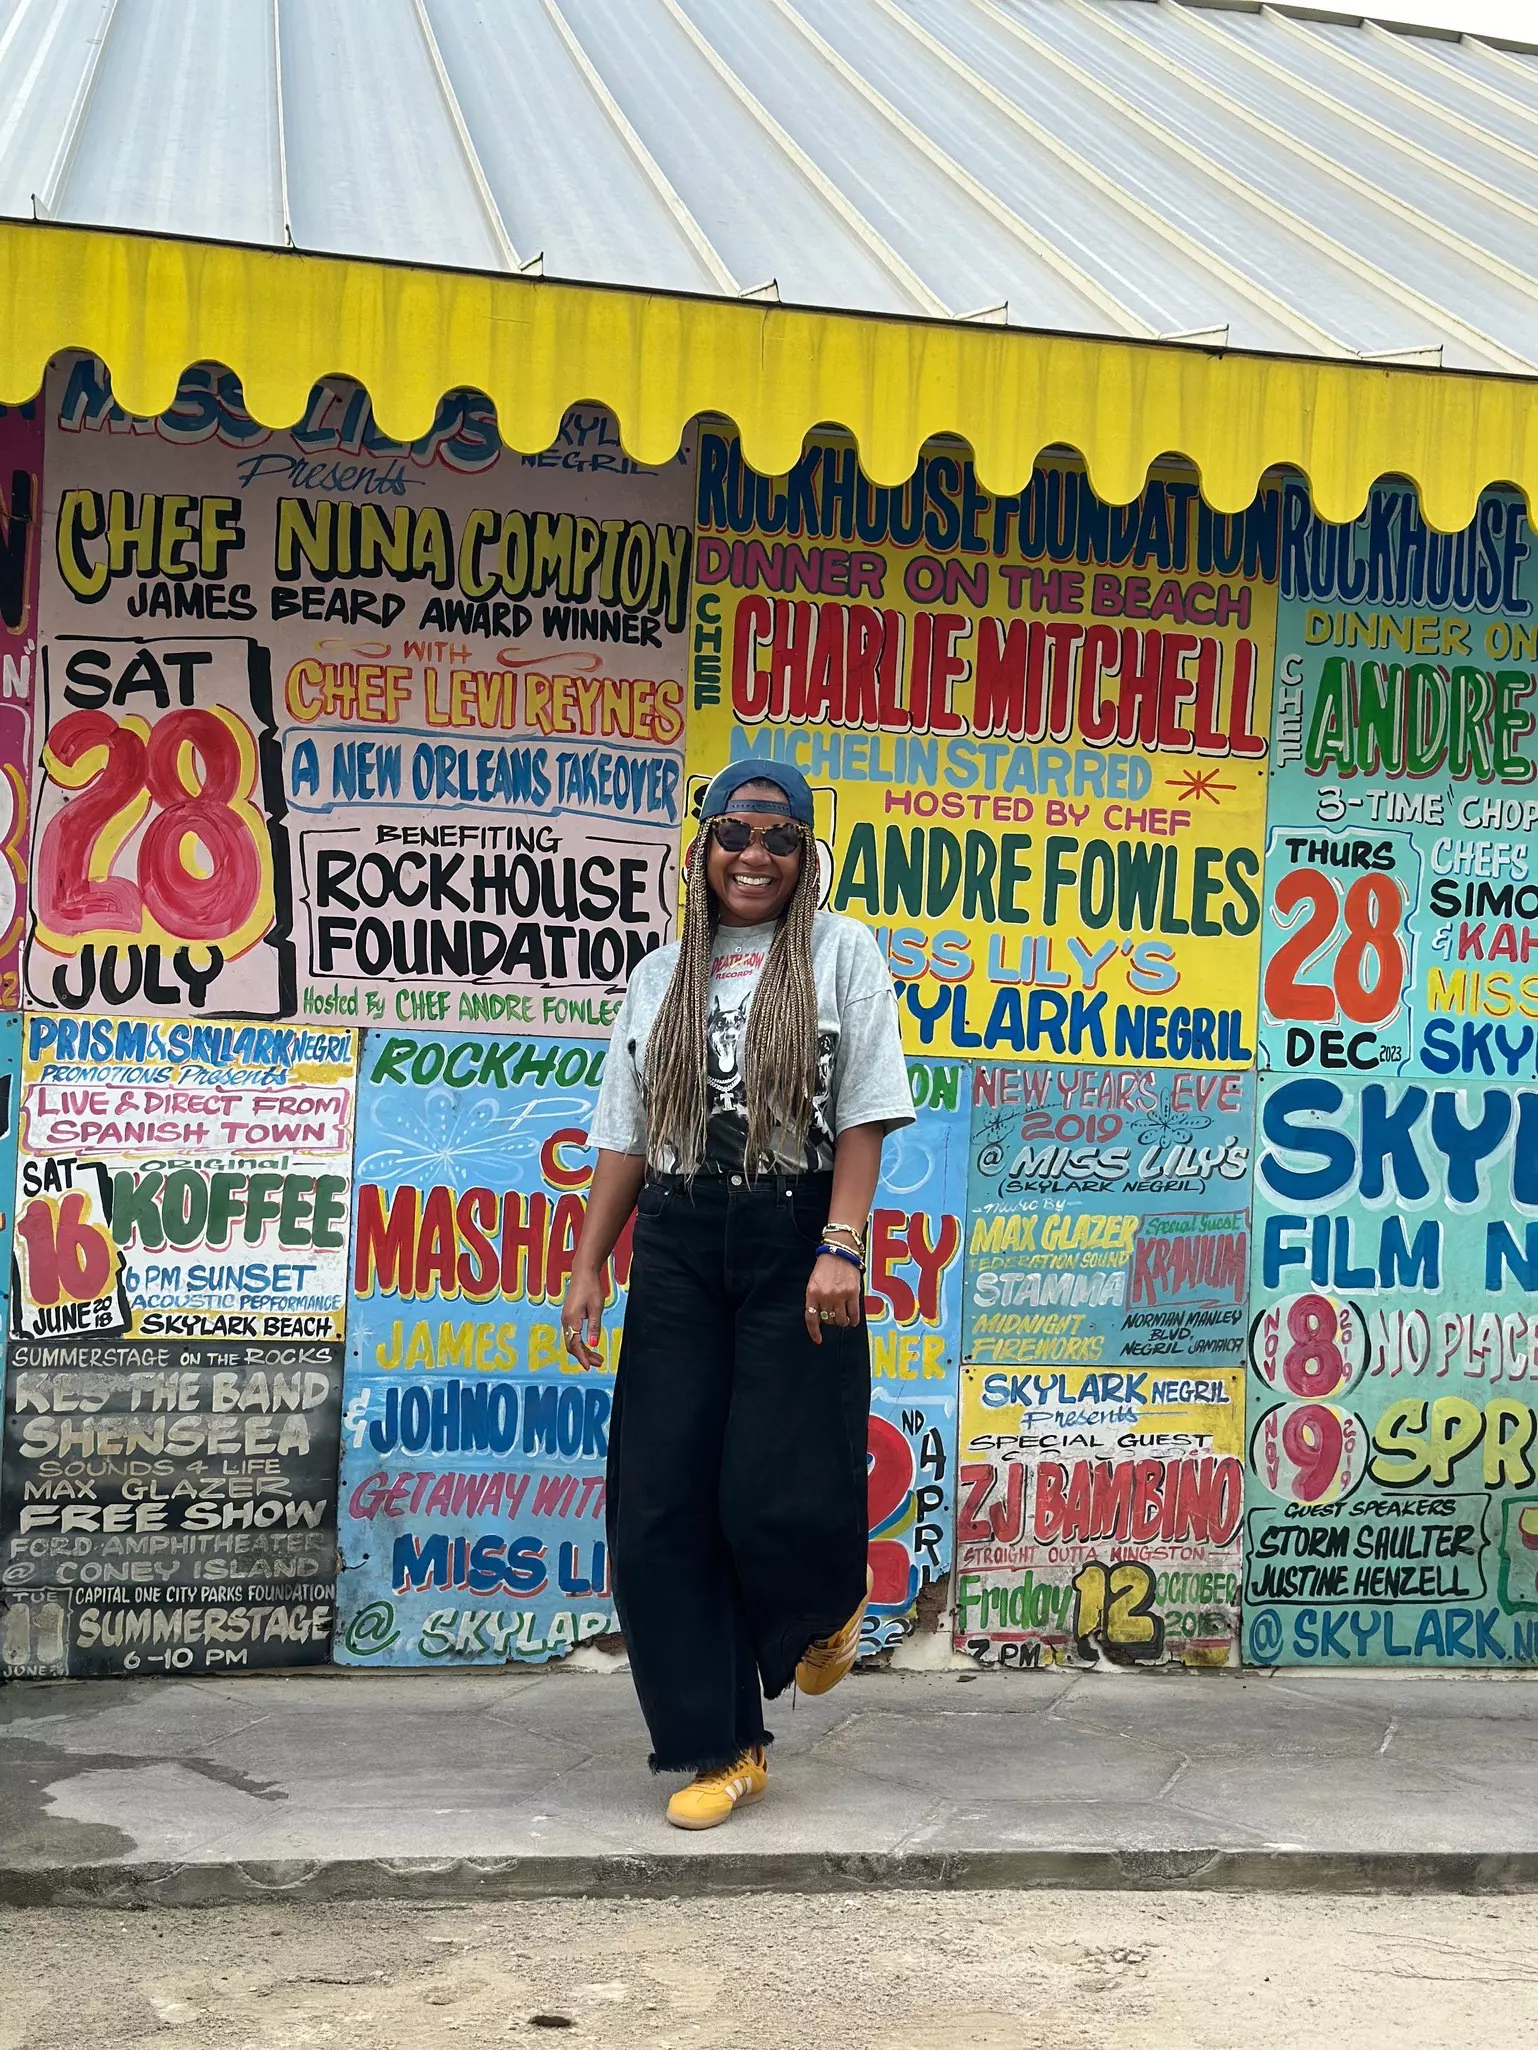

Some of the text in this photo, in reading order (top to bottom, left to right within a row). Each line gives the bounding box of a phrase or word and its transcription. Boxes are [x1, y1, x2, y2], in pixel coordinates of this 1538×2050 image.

[236, 454, 426, 496] Presents
[697, 434, 1283, 584] ROCKHOUSE FOUNDATION
[56, 489, 246, 604] CHEF
[275, 497, 455, 591] NINA
[458, 508, 692, 634] COMPTON
[1280, 484, 1532, 617] ROCKHOUSE
[695, 537, 1251, 630] DINNER ON THE BEACH
[127, 582, 663, 648] JAMES BEARD AWARD WINNER
[1305, 608, 1538, 662] DINNER ON
[404, 640, 473, 665] WITH
[694, 593, 722, 711] CHEF
[63, 648, 212, 709] SAT
[731, 594, 1269, 759] CHARLIE MITCHELL
[285, 657, 684, 745] CHEF LEVI REYNES
[1304, 656, 1538, 785] ANDRE
[291, 738, 320, 798] A
[333, 741, 401, 800] NEW
[412, 742, 552, 806] ORLEANS
[556, 747, 680, 822] TAKEOVER
[730, 725, 1153, 801] MICHELIN STARRED
[885, 789, 1191, 836] HOSTED BY CHEF
[1315, 785, 1445, 827] 3-TIME
[37, 704, 276, 962] 28
[375, 825, 563, 854] BENEFITING
[1286, 838, 1397, 870] THURS
[834, 822, 1261, 938] ANDRE FOWLES
[1431, 836, 1529, 881] CHEFS
[317, 850, 650, 922] ROCKHOUSE
[317, 916, 660, 982] FOUNDATION
[987, 932, 1181, 995] LILY'S
[1264, 868, 1410, 1031] 28
[53, 944, 224, 1010] JULY
[303, 982, 533, 1022] Hosted By CHEF ANDRE
[29, 1016, 352, 1067] PRISM SKYLARK NEGRIL
[1115, 1005, 1253, 1061] NEGRIL
[1286, 1027, 1402, 1070] DEC 2023
[41, 1064, 291, 1086] PROMOTIONS Presents
[973, 1065, 1051, 1109] NEW
[1057, 1068, 1158, 1113] YEAR'S
[1171, 1071, 1243, 1113] EVE
[38, 1089, 109, 1118] LIVE
[114, 1091, 140, 1116] &
[144, 1091, 242, 1116] DIRECT
[253, 1096, 341, 1115] FROM
[50, 1121, 326, 1145] SPANISH TOWN
[1020, 1111, 1124, 1144] 2019
[23, 1157, 78, 1198] SAT
[1008, 1135, 1250, 1181] MISS LILY'S
[997, 1177, 1206, 1199] (SKYLARK NEGRIL)
[112, 1169, 350, 1254] KOFFEE
[969, 1213, 1140, 1255] MAX GLAZER
[17, 1190, 124, 1308] 16
[1132, 1231, 1247, 1306] KRANIUM
[1263, 1214, 1445, 1296] FILM
[125, 1263, 317, 1294] 6 PM SUNSET
[973, 1271, 1126, 1308] STAMMA
[33, 1302, 92, 1337] JUNE
[130, 1294, 235, 1310] ACOUSTIC
[971, 1313, 1087, 1336] MIDNIGHT
[1120, 1310, 1243, 1331] NORMAN MANLEY
[140, 1313, 333, 1338] SKYLARK BEACH
[376, 1320, 517, 1373] JAMES
[970, 1335, 1105, 1361] FIREWORKS
[1119, 1337, 1244, 1357] NEGRIL JAMAICA
[1283, 1294, 1344, 1398] 8
[1369, 1308, 1431, 1378] NO
[11, 1347, 334, 1368] SUMMERSTAGE ON THE ROCKS
[130, 1371, 330, 1413] THE BAND
[982, 1372, 1230, 1408] SKYLARK NEGRIL
[19, 1414, 312, 1459] SHENSEEA
[369, 1379, 520, 1461] JOHNO
[969, 1433, 1213, 1450] SPECIAL GUEST
[38, 1458, 282, 1477] SOUNDS 4 LIFE
[1282, 1403, 1343, 1501] 9
[24, 1477, 293, 1501] MAX GLAZER
[350, 1471, 531, 1520] GETAWAY
[957, 1463, 1026, 1546] ZJ
[1034, 1456, 1246, 1548] BAMBINO
[1283, 1498, 1457, 1519] GUEST SPEAKERS
[20, 1499, 328, 1534] FREE SHOW
[11, 1532, 327, 1558] FORD AMPHITHEATER
[963, 1545, 1206, 1568] STRAIGHT OUTTA KINGSTON
[1255, 1524, 1475, 1561] STORM SAULTER
[2, 1557, 320, 1586] @ CONEY ISLAND
[392, 1533, 548, 1598] MISS
[1251, 1564, 1470, 1599] JUSTINE HENZELL
[75, 1582, 335, 1605] CAPITAL ONE CITY PARKS FOUNDATION
[958, 1569, 1074, 1630] Friday
[1072, 1560, 1166, 1661] 12
[1155, 1571, 1239, 1606] OCTOBER
[76, 1605, 334, 1648] SUMMERSTAGE
[345, 1600, 401, 1657] @
[1250, 1608, 1284, 1665] @
[1292, 1606, 1507, 1661] SKYLARK
[205, 1648, 249, 1666] PM
[1000, 1643, 1041, 1667] PM
